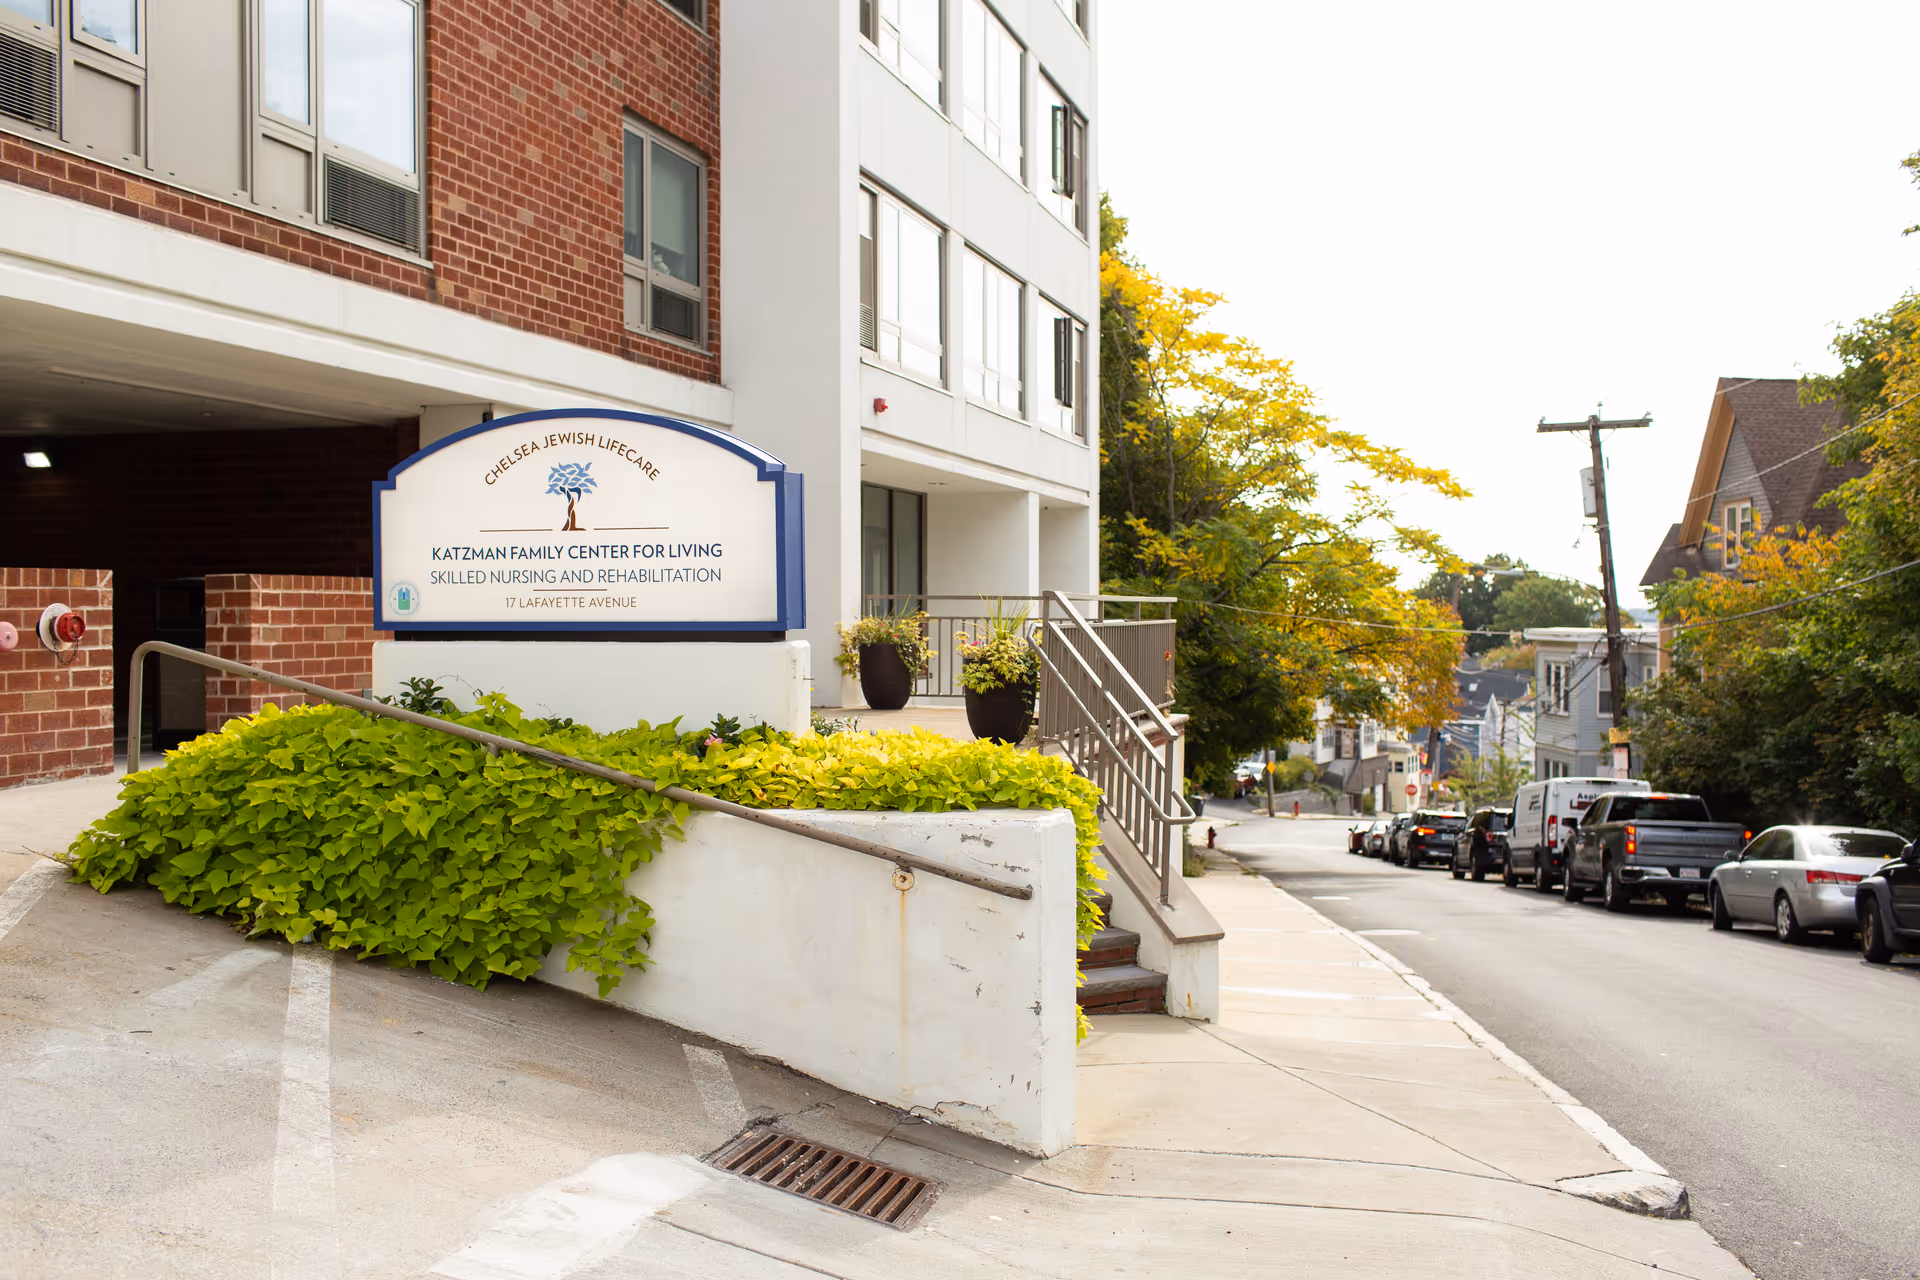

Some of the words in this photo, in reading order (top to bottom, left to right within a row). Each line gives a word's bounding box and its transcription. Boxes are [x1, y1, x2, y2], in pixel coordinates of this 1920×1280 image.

[484, 441, 540, 485] CHELSEA
[543, 432, 595, 449] JEWISH
[598, 436, 660, 481] LIFECARE
[432, 546, 507, 561] KATZMAN
[510, 545, 564, 560] FAMILY
[568, 545, 629, 559] CENTER
[633, 544, 665, 558] FOR
[668, 543, 723, 558] LIVING
[430, 570, 487, 584] SKILLED
[490, 570, 557, 584] NURSING
[560, 569, 594, 583] AND
[598, 568, 722, 583] REHABILITATION
[505, 597, 516, 608] 17
[519, 597, 586, 608] LAFAYETTE
[589, 597, 637, 608] AVENUE
